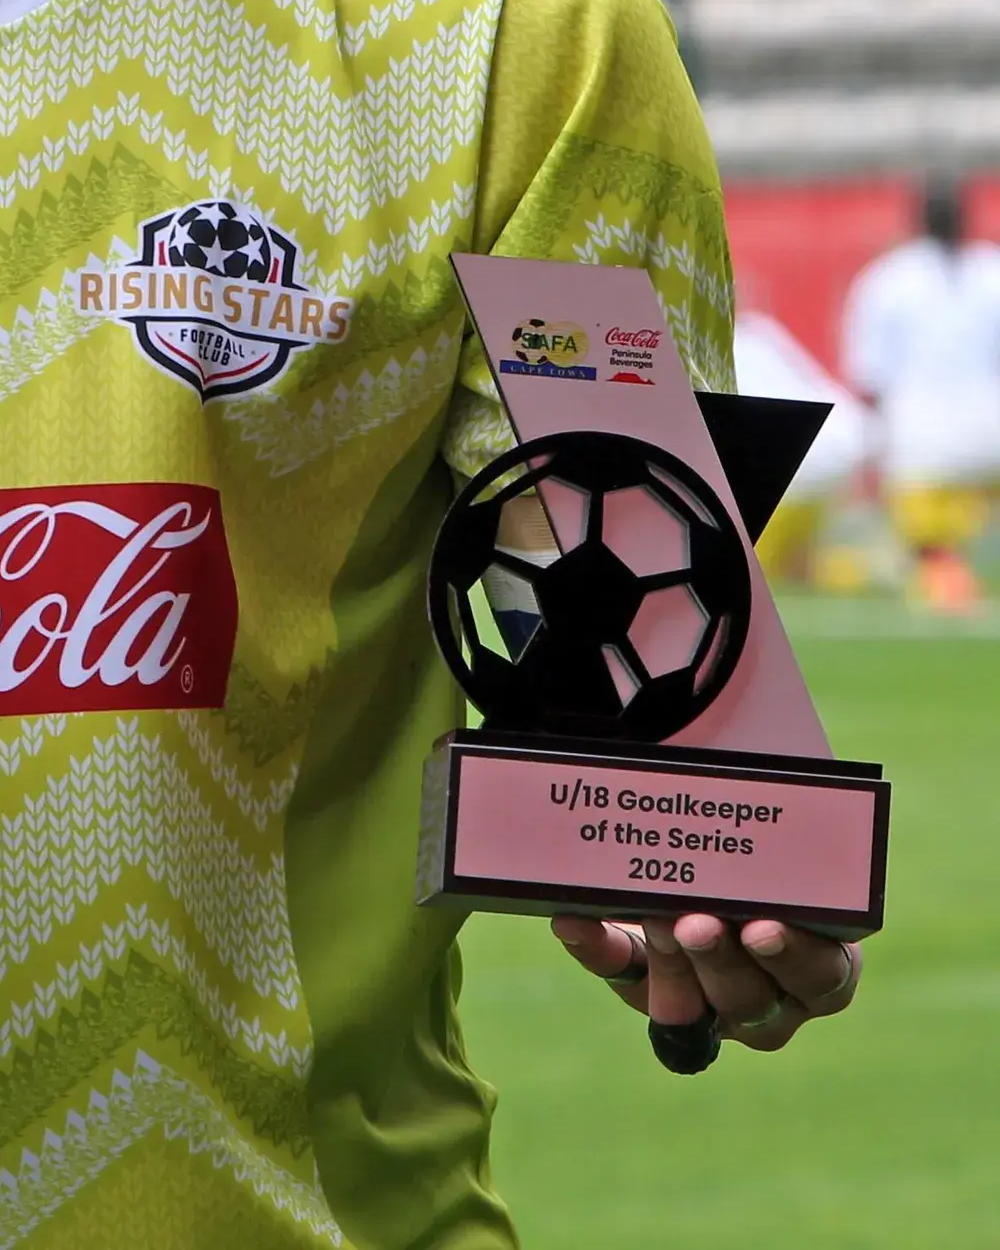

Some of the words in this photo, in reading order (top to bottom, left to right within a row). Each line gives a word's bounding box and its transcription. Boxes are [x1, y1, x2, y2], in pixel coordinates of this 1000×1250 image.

[79, 272, 214, 313] RISING
[222, 285, 350, 340] STARS
[180, 328, 245, 358] FOOTBALL
[521, 332, 578, 354] SAFA
[605, 327, 663, 349] Coca-Cola
[198, 345, 231, 366] CLUB
[609, 357, 654, 369] Beverages
[612, 349, 653, 360] Peninsula
[510, 365, 545, 375] CAPE
[549, 779, 610, 811] U/18
[616, 789, 784, 828] Goalkeeper
[579, 819, 607, 843] of
[614, 822, 660, 847] the
[667, 827, 755, 856] Series
[628, 857, 696, 885] 2026
